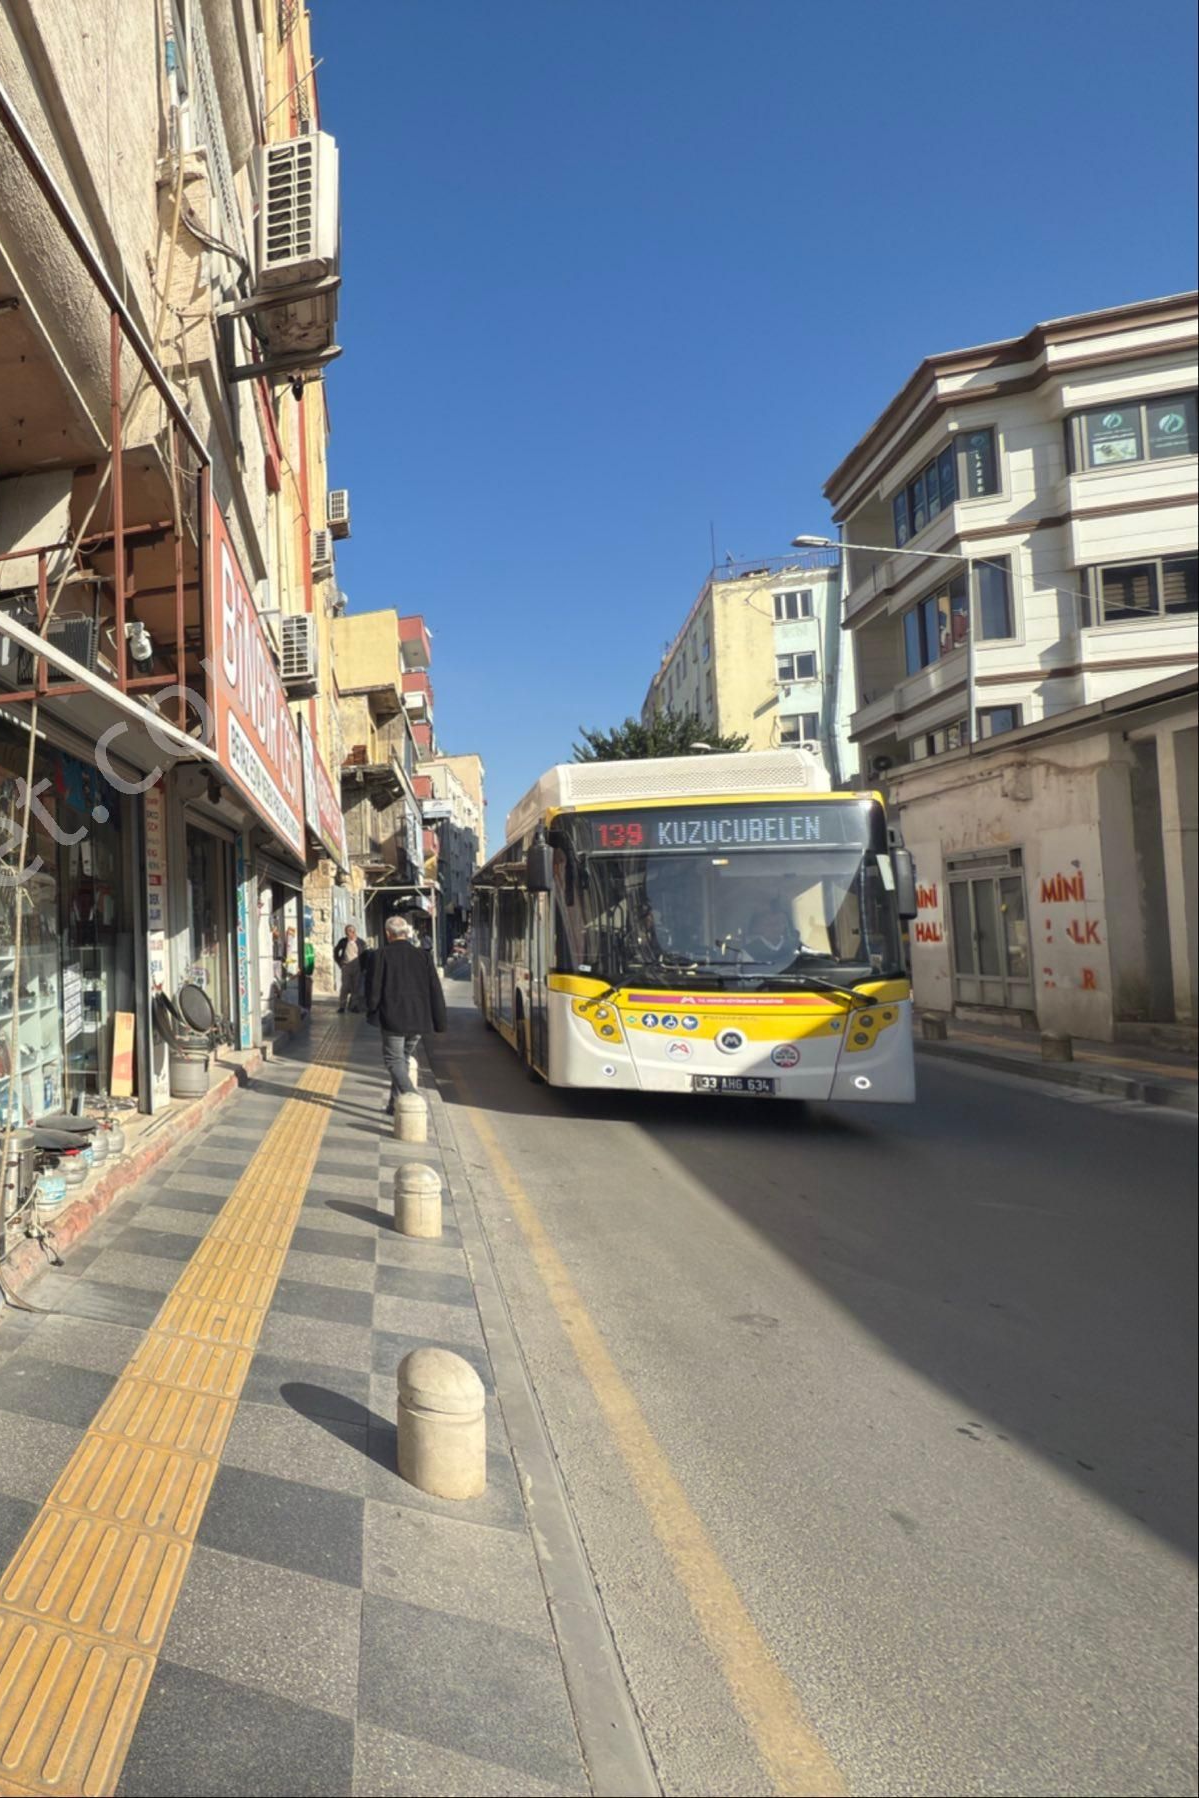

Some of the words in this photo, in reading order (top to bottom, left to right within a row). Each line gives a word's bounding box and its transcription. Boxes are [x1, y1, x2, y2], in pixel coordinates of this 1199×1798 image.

[598, 823, 643, 847] 139
[658, 816, 820, 845] KUZUCUBELEN
[702, 1076, 717, 1089] 33
[747, 1079, 770, 1091] 634
